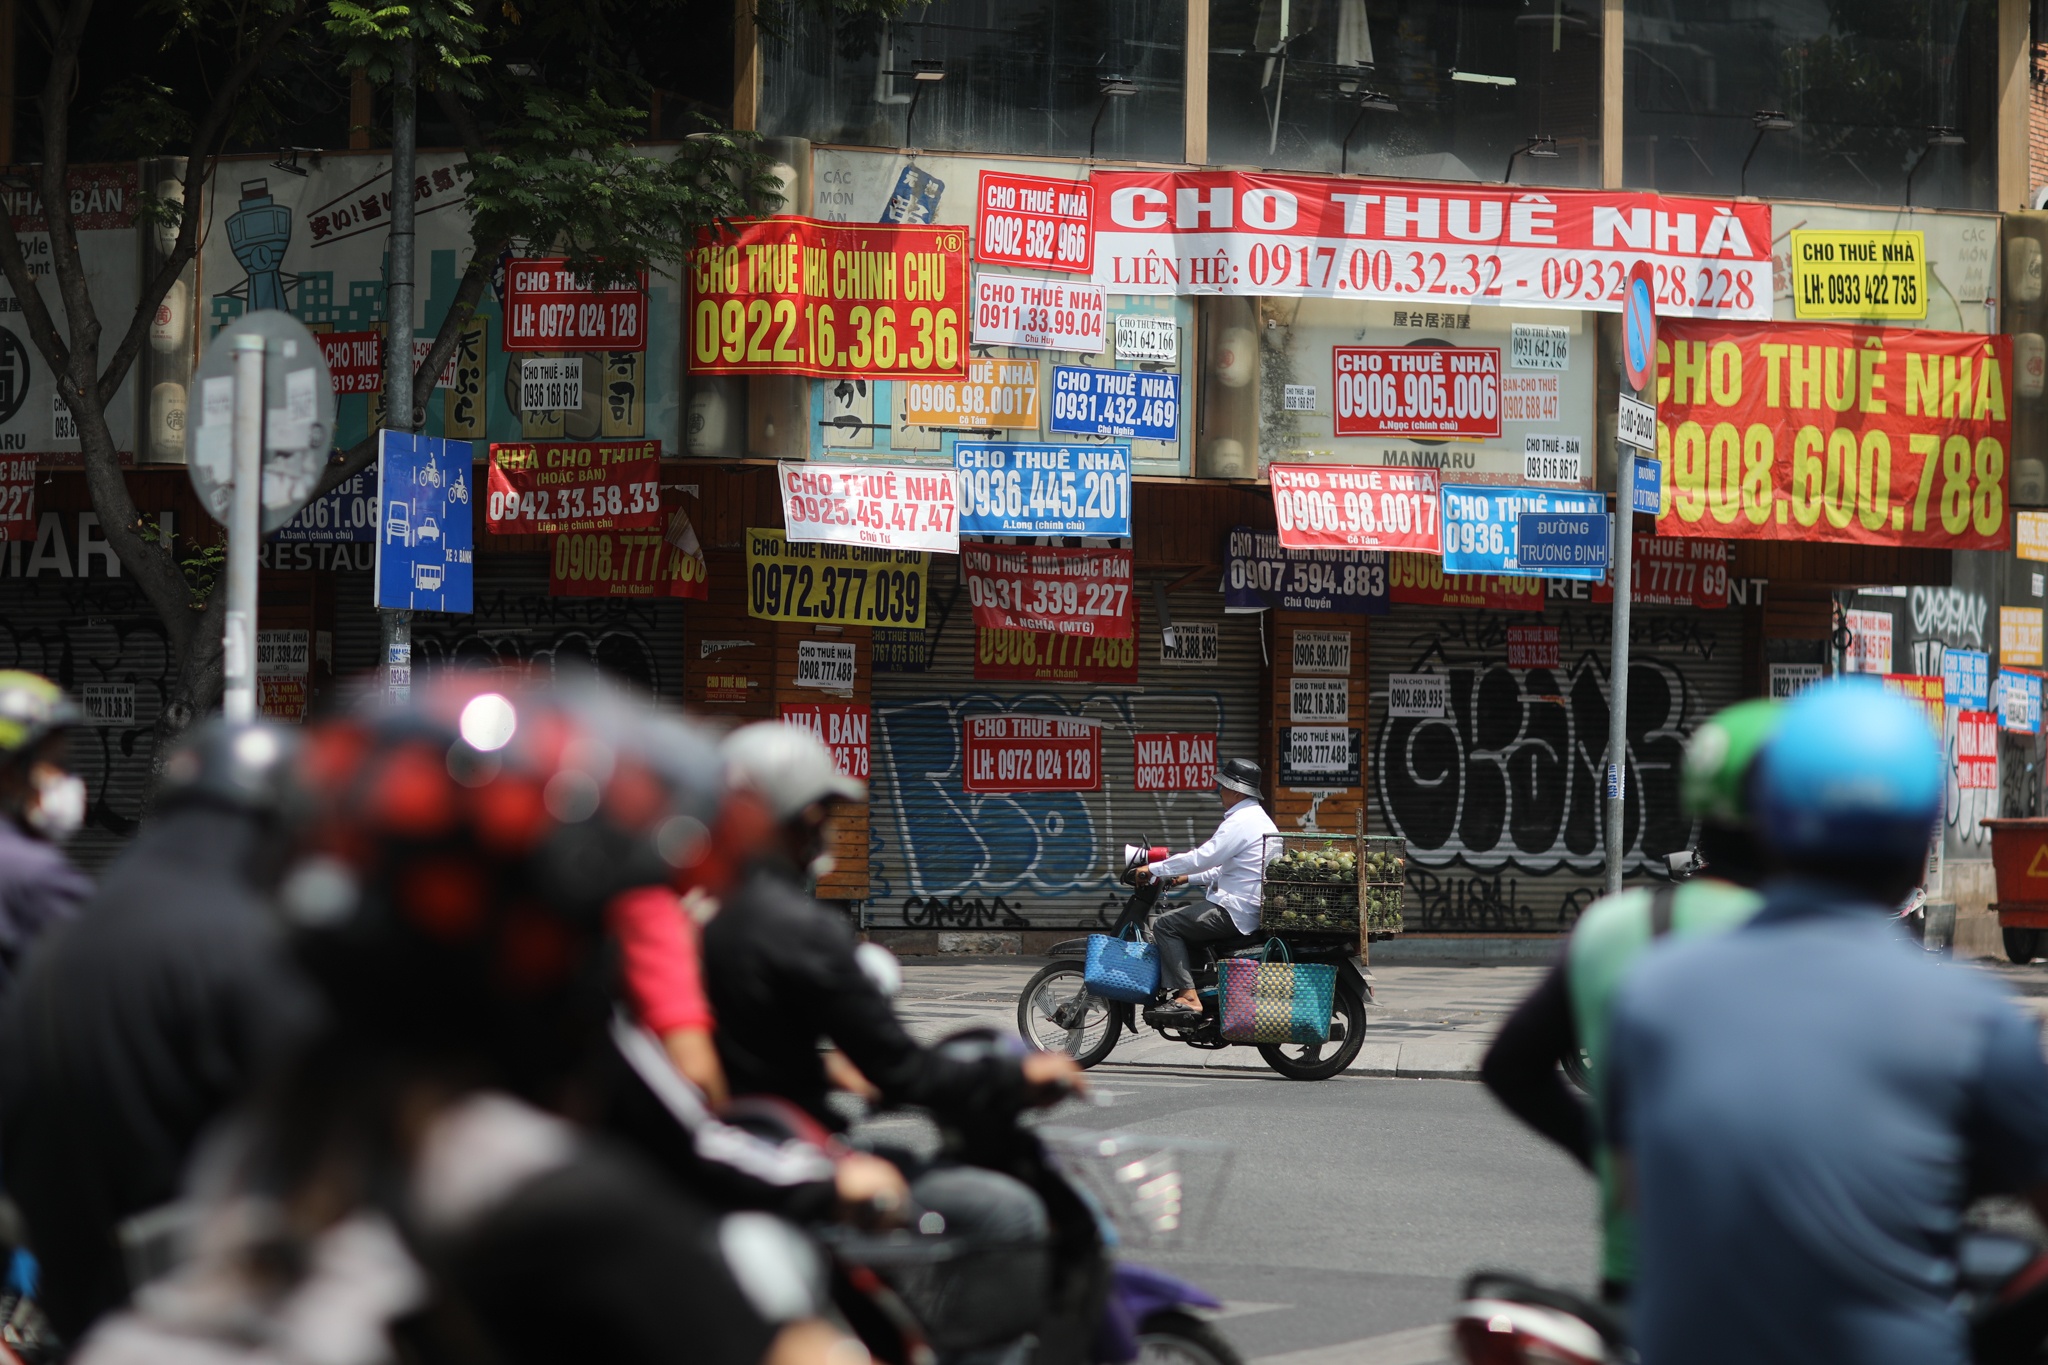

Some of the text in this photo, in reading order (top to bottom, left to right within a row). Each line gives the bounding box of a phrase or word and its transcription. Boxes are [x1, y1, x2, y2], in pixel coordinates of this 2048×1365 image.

[70, 182, 123, 213] BẢN
[820, 188, 854, 206] MÓN
[986, 184, 1088, 219] CHO THUÊ NHÀ
[1110, 185, 1755, 258] CHO THUÊ NHÀ
[984, 214, 1087, 263] 0902 582 966
[1803, 240, 1915, 262] CHO THUÊ NHÀ
[696, 233, 946, 301] CHO THUÊ NHÀ CHÍNH CHỦ
[1112, 248, 1181, 286] LIÊN
[1188, 248, 1240, 293] HỆ:
[1248, 242, 1503, 299] 0917.00.32.32
[1541, 257, 1756, 311] 093228.228
[516, 271, 549, 292] CHO
[1804, 274, 1917, 305] LH: 0933 422 735
[980, 283, 1103, 313] CHO THUÊ NHÀ
[539, 304, 637, 338] 0972 024 128
[979, 303, 1101, 338] 0911.33.99.04
[1393, 311, 1471, 330] 屋台居酒屋
[696, 298, 959, 370] 0922.16.36.36
[1532, 327, 1567, 341] THUÊ NHÀ
[325, 336, 380, 367] CHO THUÊ
[1513, 337, 1533, 357] 0931
[541, 361, 558, 380] THUÊ
[1000, 362, 1036, 387] NHÀ
[1338, 351, 1497, 374] CHO THUÊ NHÀ
[357, 373, 380, 391] 257
[1056, 370, 1176, 405] CHO THUÊ NHÀ
[1503, 375, 1536, 393] BÁN-CHO
[1759, 335, 1888, 414] THUÊ
[1904, 343, 2007, 422] NHÀ
[524, 383, 578, 408] 0936 168 612
[910, 384, 1038, 417] 0906.98.0017
[1338, 373, 1498, 421] 0906.905.006
[1503, 395, 1523, 419] 0902
[1055, 392, 1176, 429] 0931.432.469
[1620, 406, 1653, 440] 6:00 20:00
[496, 442, 655, 471] NHÀ CHO THUÊ
[1526, 437, 1560, 453] CHO THUÊ
[959, 448, 1126, 471] CHO THUÊ NHÀ
[1383, 449, 1476, 469] MANMARU
[1560, 458, 1578, 478] 8612
[577, 467, 607, 483] BÁN)
[787, 470, 954, 502] CHO THUÊ NHÀ
[1277, 470, 1435, 500] CHO THUÊ NHÀ
[1638, 465, 1655, 482] ĐƯỜNG
[489, 482, 660, 521] 0942.33.58.33
[960, 469, 1127, 520] 0936.445.201
[1645, 491, 1659, 511] TRỌNG
[790, 495, 955, 533] 0925.45.47.47
[1277, 490, 1437, 536] 0906.98.0017
[1446, 494, 1489, 522] CHO
[1537, 518, 1589, 536] ĐƯỜNG
[446, 546, 472, 564] XE 2 BÁNH
[1521, 543, 1605, 565] TRƯƠNG ĐỊNH
[1638, 537, 1727, 561] THUÊ NHÀ
[965, 552, 1130, 581] CHO THUÊ HOẶC BÁN
[1231, 559, 1385, 598] 0907.594.883
[1650, 562, 1697, 594] 7777
[1702, 566, 1727, 597] 69
[752, 562, 921, 623] 0972.377.039
[968, 575, 1129, 617] 0931.339.227
[1019, 617, 1095, 636] NGHĨA (MTG)
[801, 645, 852, 660] CHO THUÊ NHÀ
[1295, 644, 1349, 668] 0906.98.0017
[799, 660, 852, 682] 0908.777.488
[1035, 668, 1079, 679] Anh Khánh
[1393, 677, 1441, 688] NHÀ CHO THUÊ
[1295, 680, 1327, 691] CHO THUÊ
[1294, 692, 1347, 716] 0922.16.36.36
[1392, 688, 1443, 709] 0902.689.935
[829, 706, 867, 745] BÁN
[974, 719, 1007, 738] CHO
[1293, 730, 1346, 743] CHO THUÊ NHÀ
[853, 747, 869, 777] 78
[1137, 734, 1214, 765] NHÀ BÁN
[1293, 745, 1347, 765] 0908.777.488
[973, 748, 1091, 781] LH: 0972 024 128
[1137, 765, 1215, 789] 0902 31 92 57
